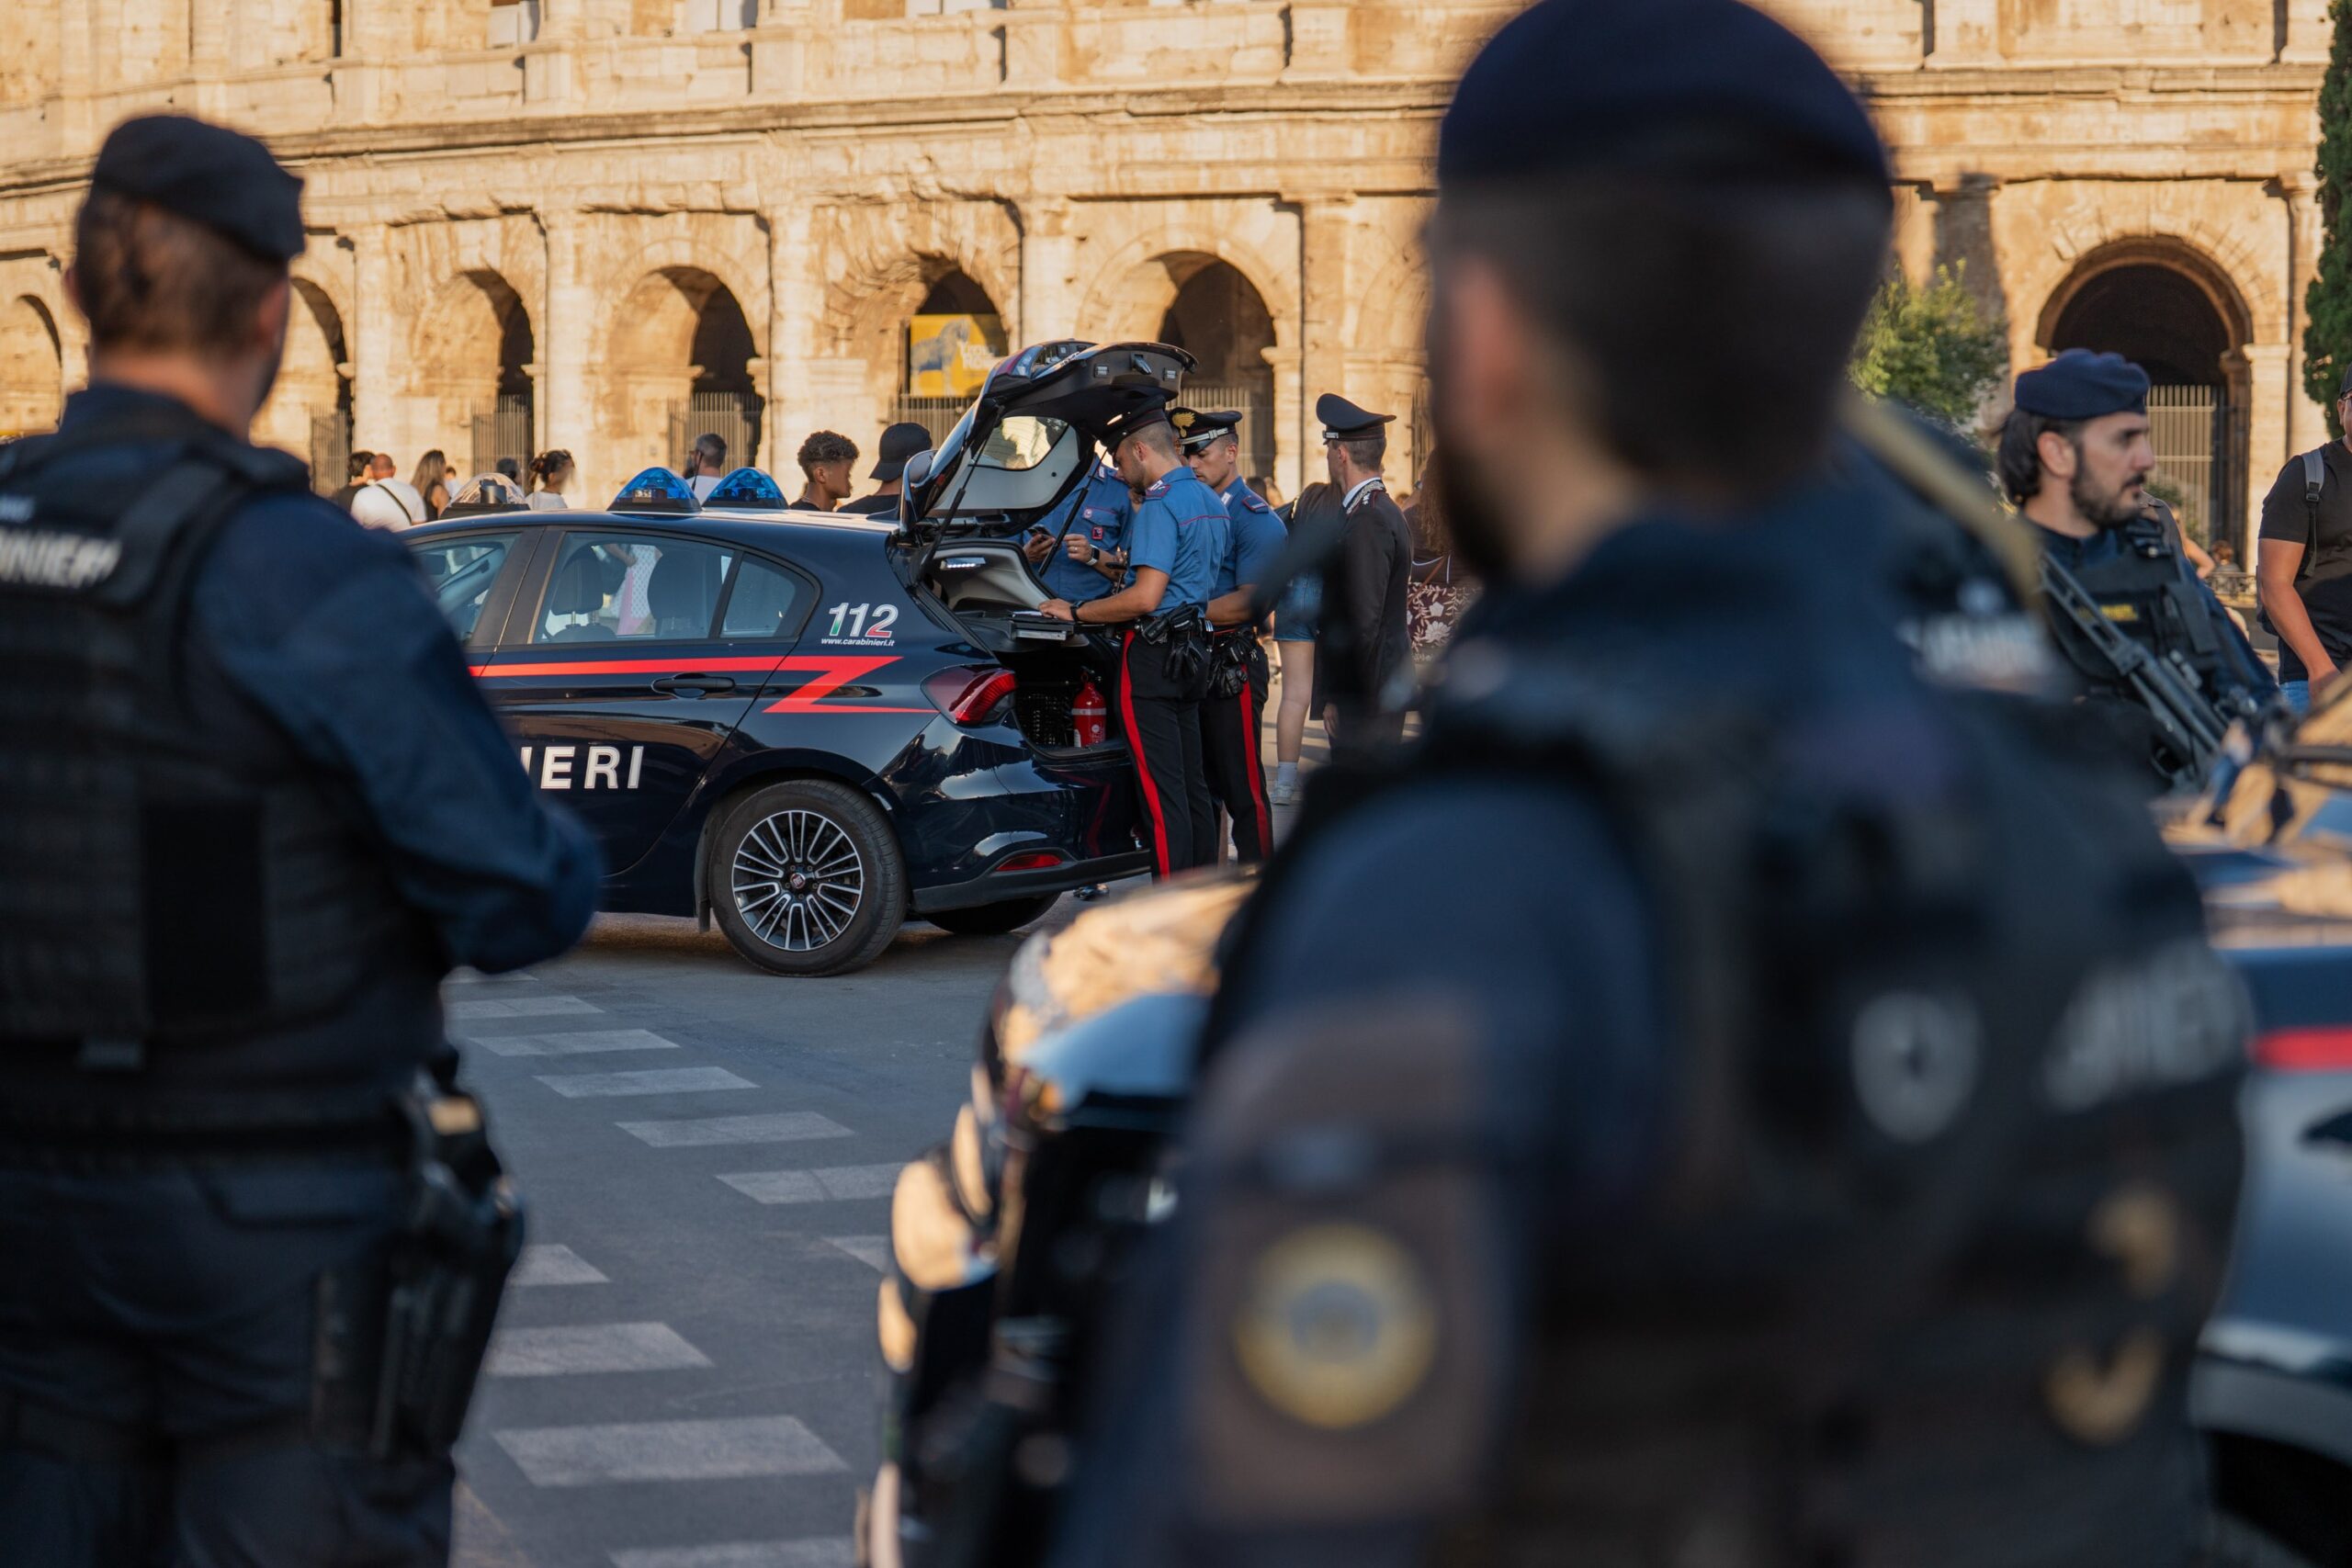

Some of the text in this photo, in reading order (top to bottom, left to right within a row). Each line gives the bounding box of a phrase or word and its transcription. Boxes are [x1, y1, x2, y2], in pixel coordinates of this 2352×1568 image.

[829, 602, 899, 638] 112
[820, 637, 896, 648] www.carabinieri.it
[520, 745, 645, 790] IERI
